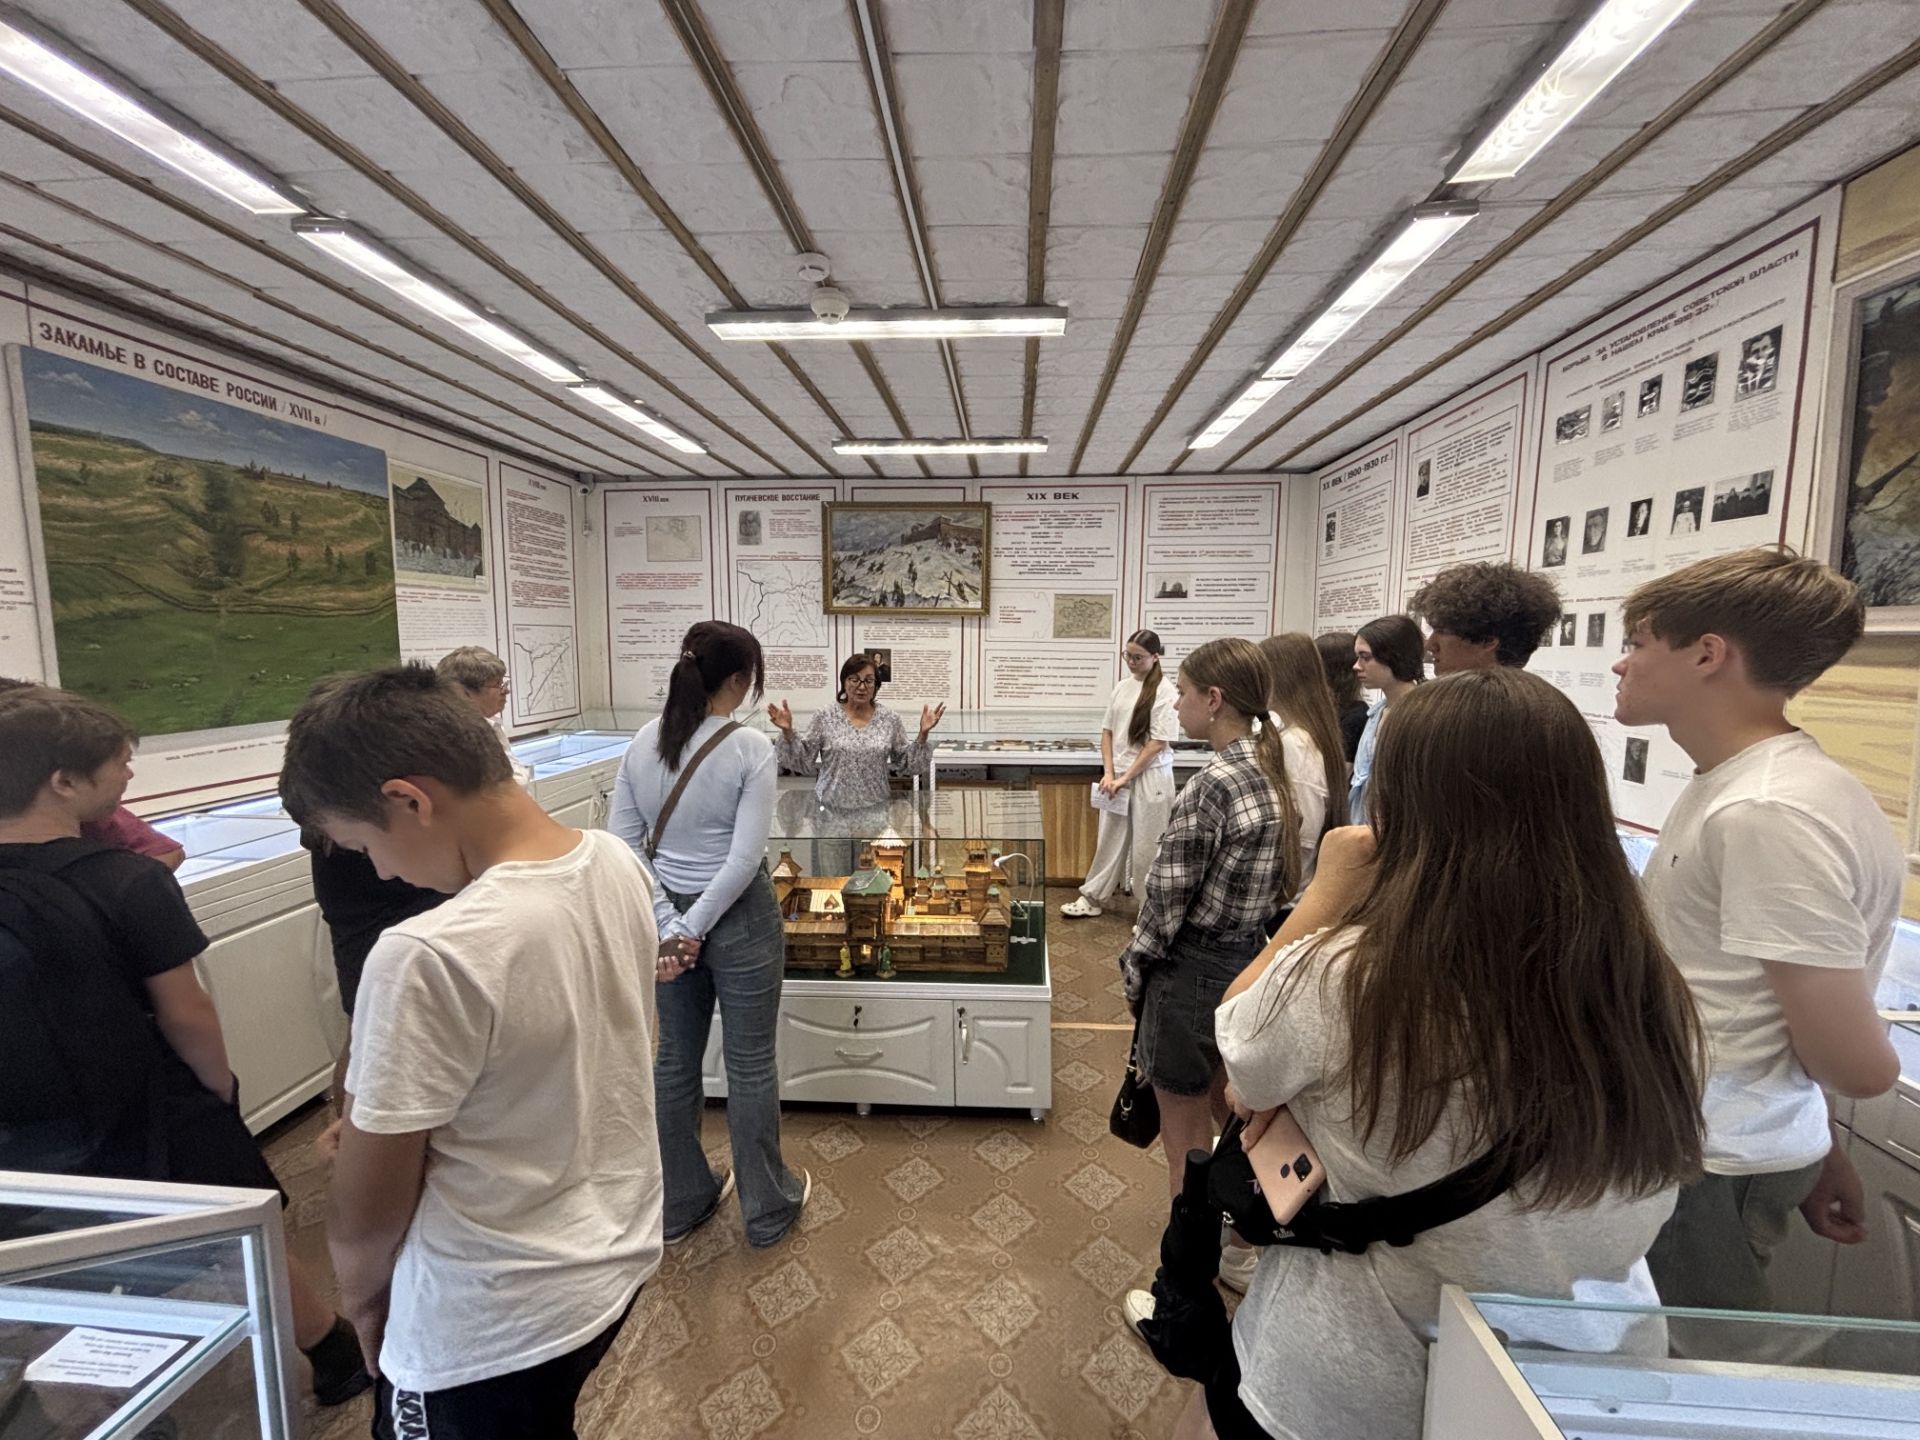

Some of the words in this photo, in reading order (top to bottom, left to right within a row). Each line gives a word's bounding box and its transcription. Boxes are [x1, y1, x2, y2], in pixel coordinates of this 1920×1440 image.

[1595, 346, 1607, 357] ЗА
[1609, 310, 1677, 349] УСТАНОВЛЕНИЕ
[1682, 276, 1745, 313] СОВЕТСКОЙ
[1748, 249, 1799, 280] ВЛАСТИ
[1610, 336, 1644, 357] НАШЕМ
[1647, 322, 1670, 339] КРАЕ
[38, 321, 127, 365] ЗАКАМЬЕ
[133, 352, 147, 370] В
[153, 359, 220, 394] СОСТАВЕ
[226, 381, 278, 412] РОССИИ
[781, 493, 821, 502] ВОССТАНИЕ
[1026, 492, 1048, 500] XIX
[1053, 492, 1080, 500] ВЕК
